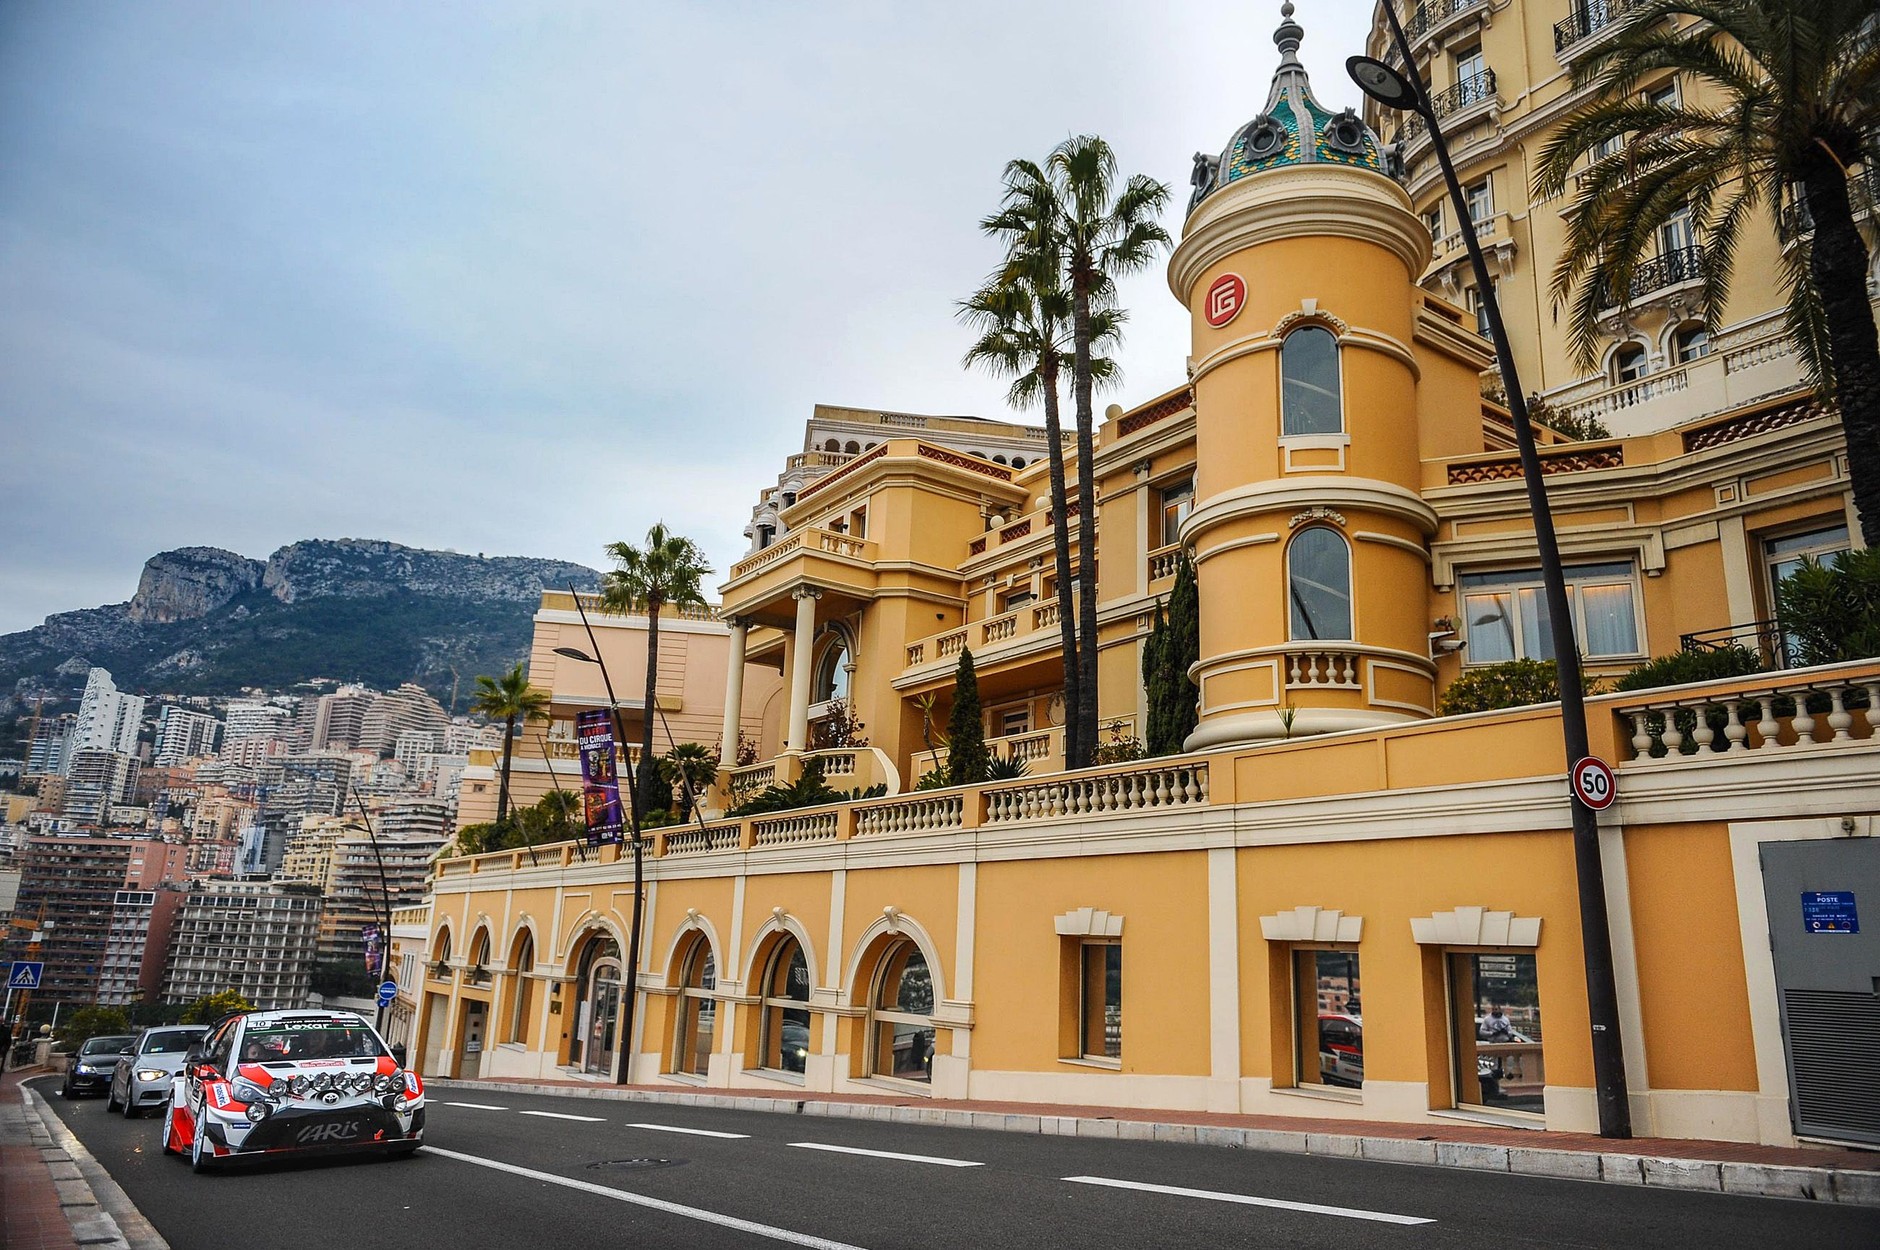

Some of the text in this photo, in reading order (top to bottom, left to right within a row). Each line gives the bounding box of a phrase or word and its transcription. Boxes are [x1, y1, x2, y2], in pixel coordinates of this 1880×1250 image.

[580, 733, 613, 745] DU CIRQUE
[1583, 772, 1607, 795] 50
